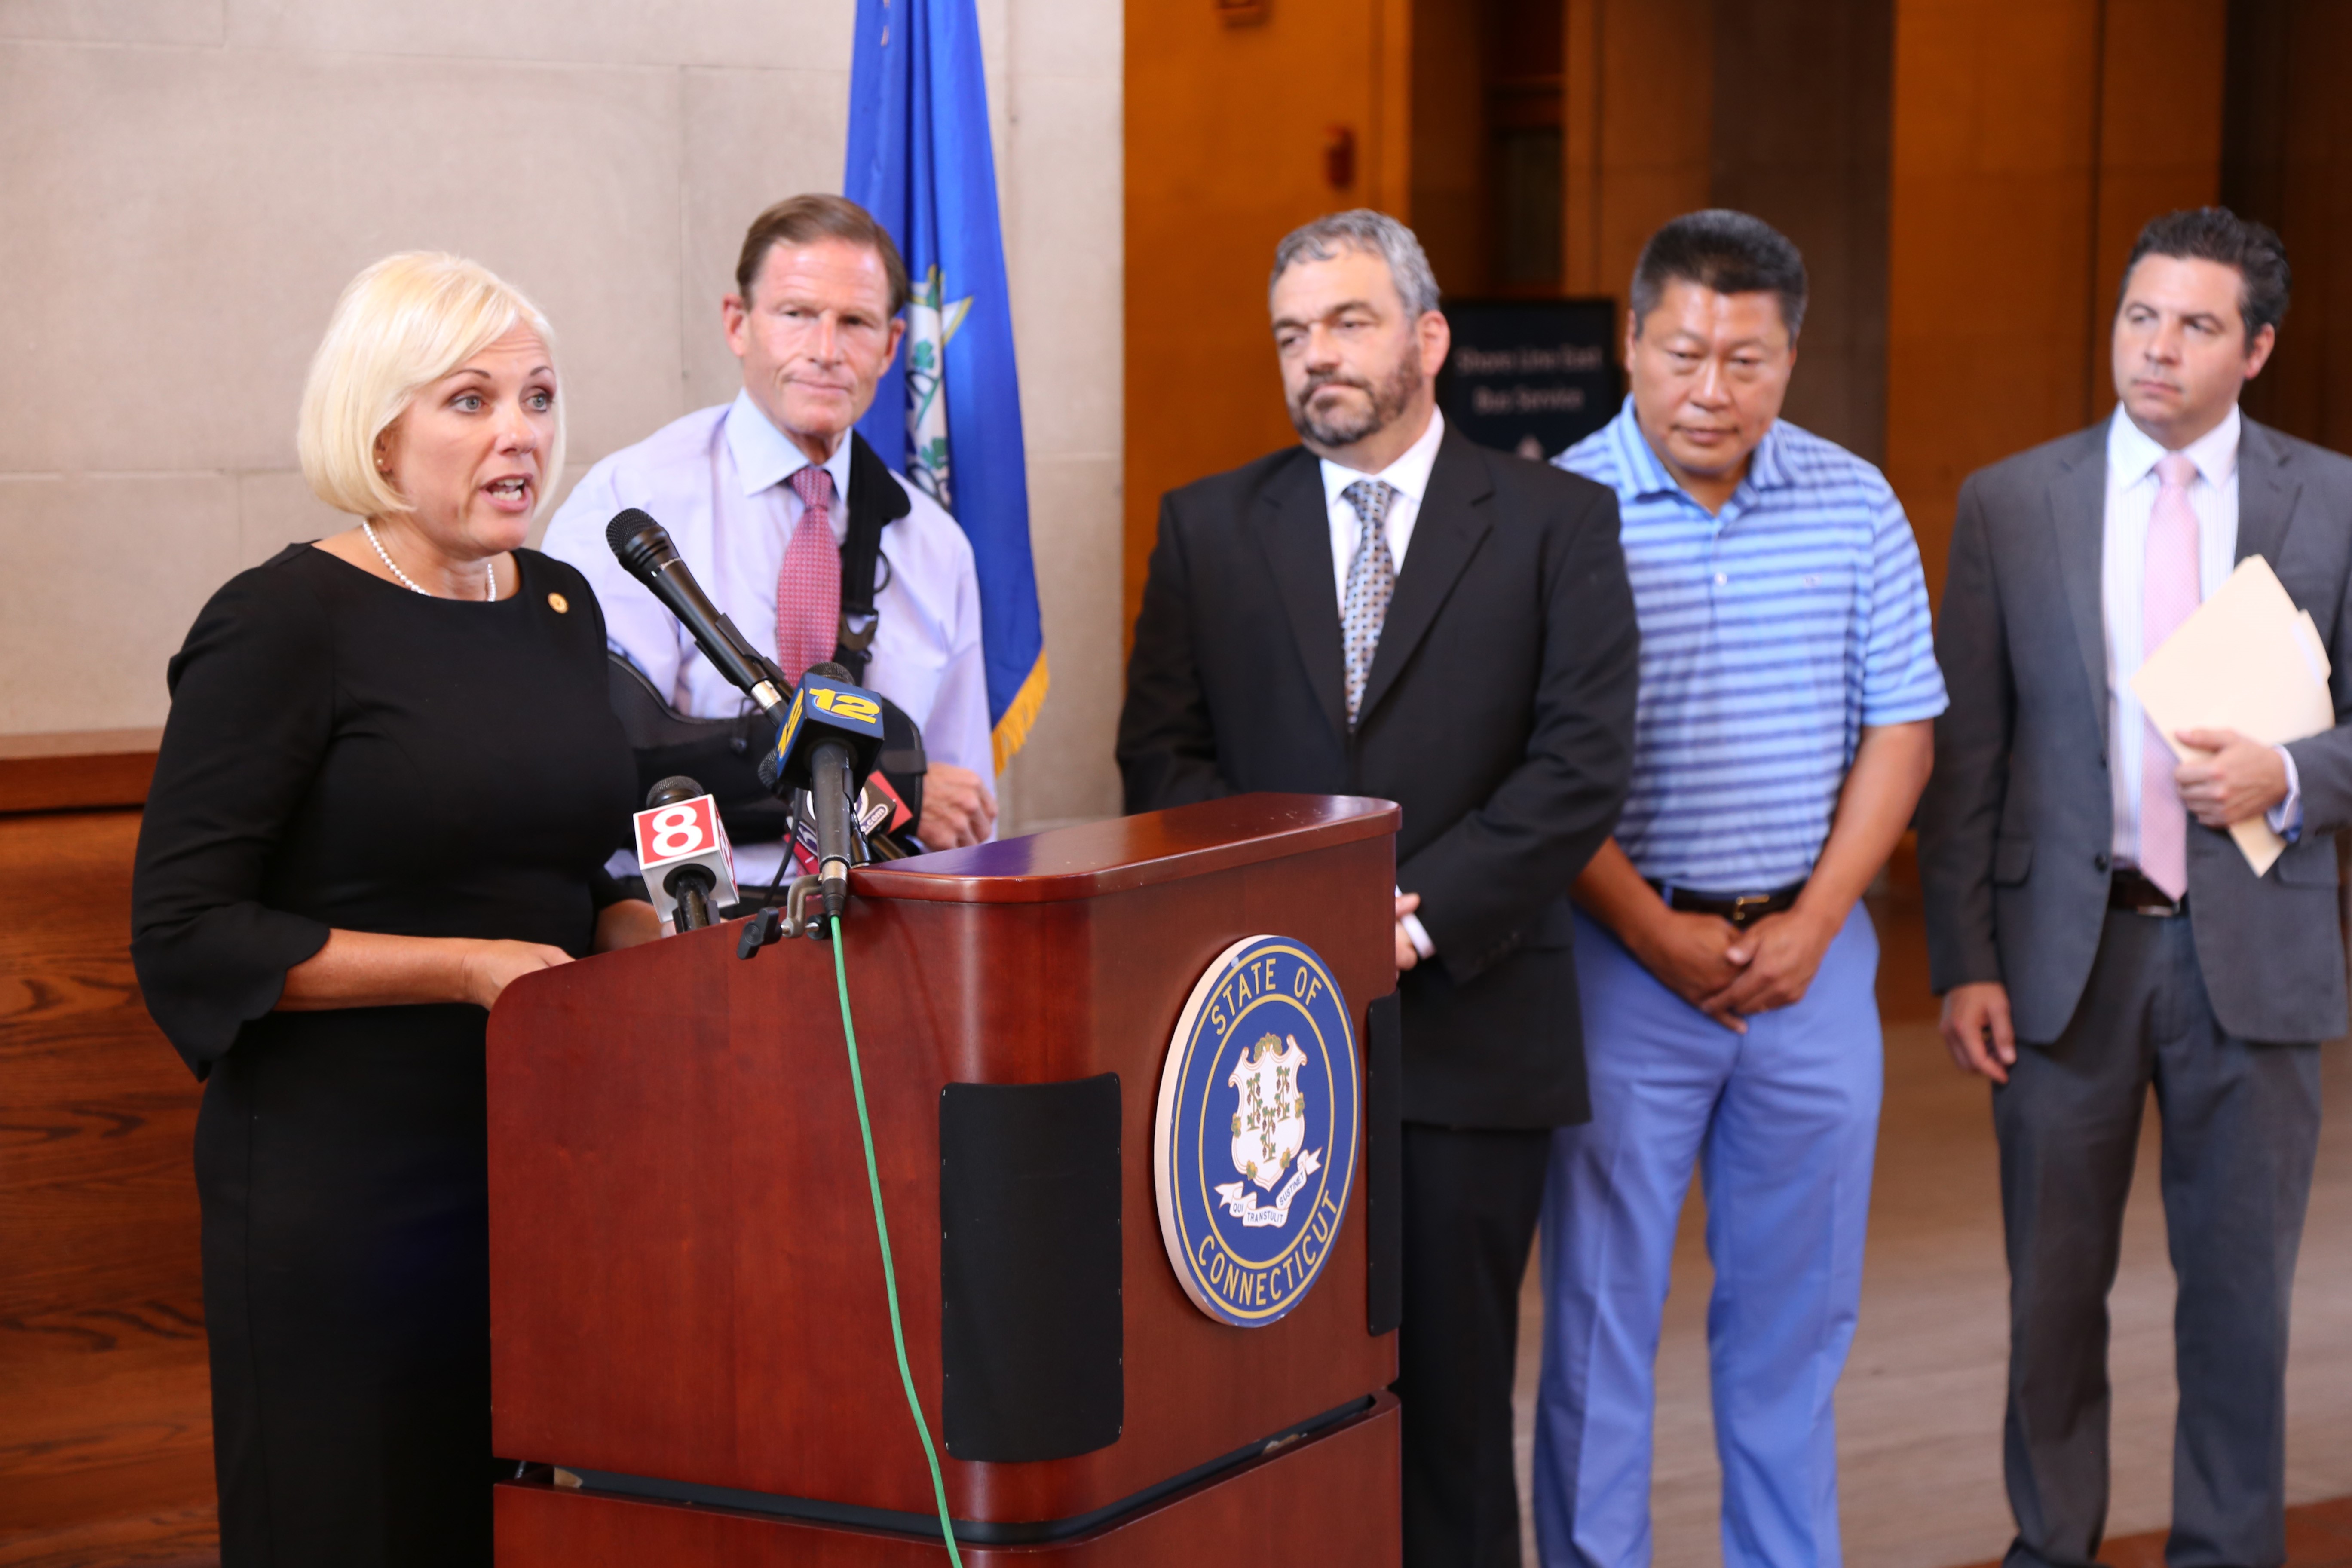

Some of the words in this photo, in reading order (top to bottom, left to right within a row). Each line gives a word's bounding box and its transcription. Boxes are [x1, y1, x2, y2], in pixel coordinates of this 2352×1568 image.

[809, 688, 879, 724] 12
[652, 805, 703, 857] 8
[1211, 959, 1276, 1035] STATE
[1294, 966, 1322, 1005] OF
[1233, 1203, 1244, 1213] QUI
[1247, 1210, 1283, 1223] TRANSTULIT
[1279, 1171, 1304, 1206] SUSTINET
[1199, 1190, 1337, 1306] CONNECTICUT
